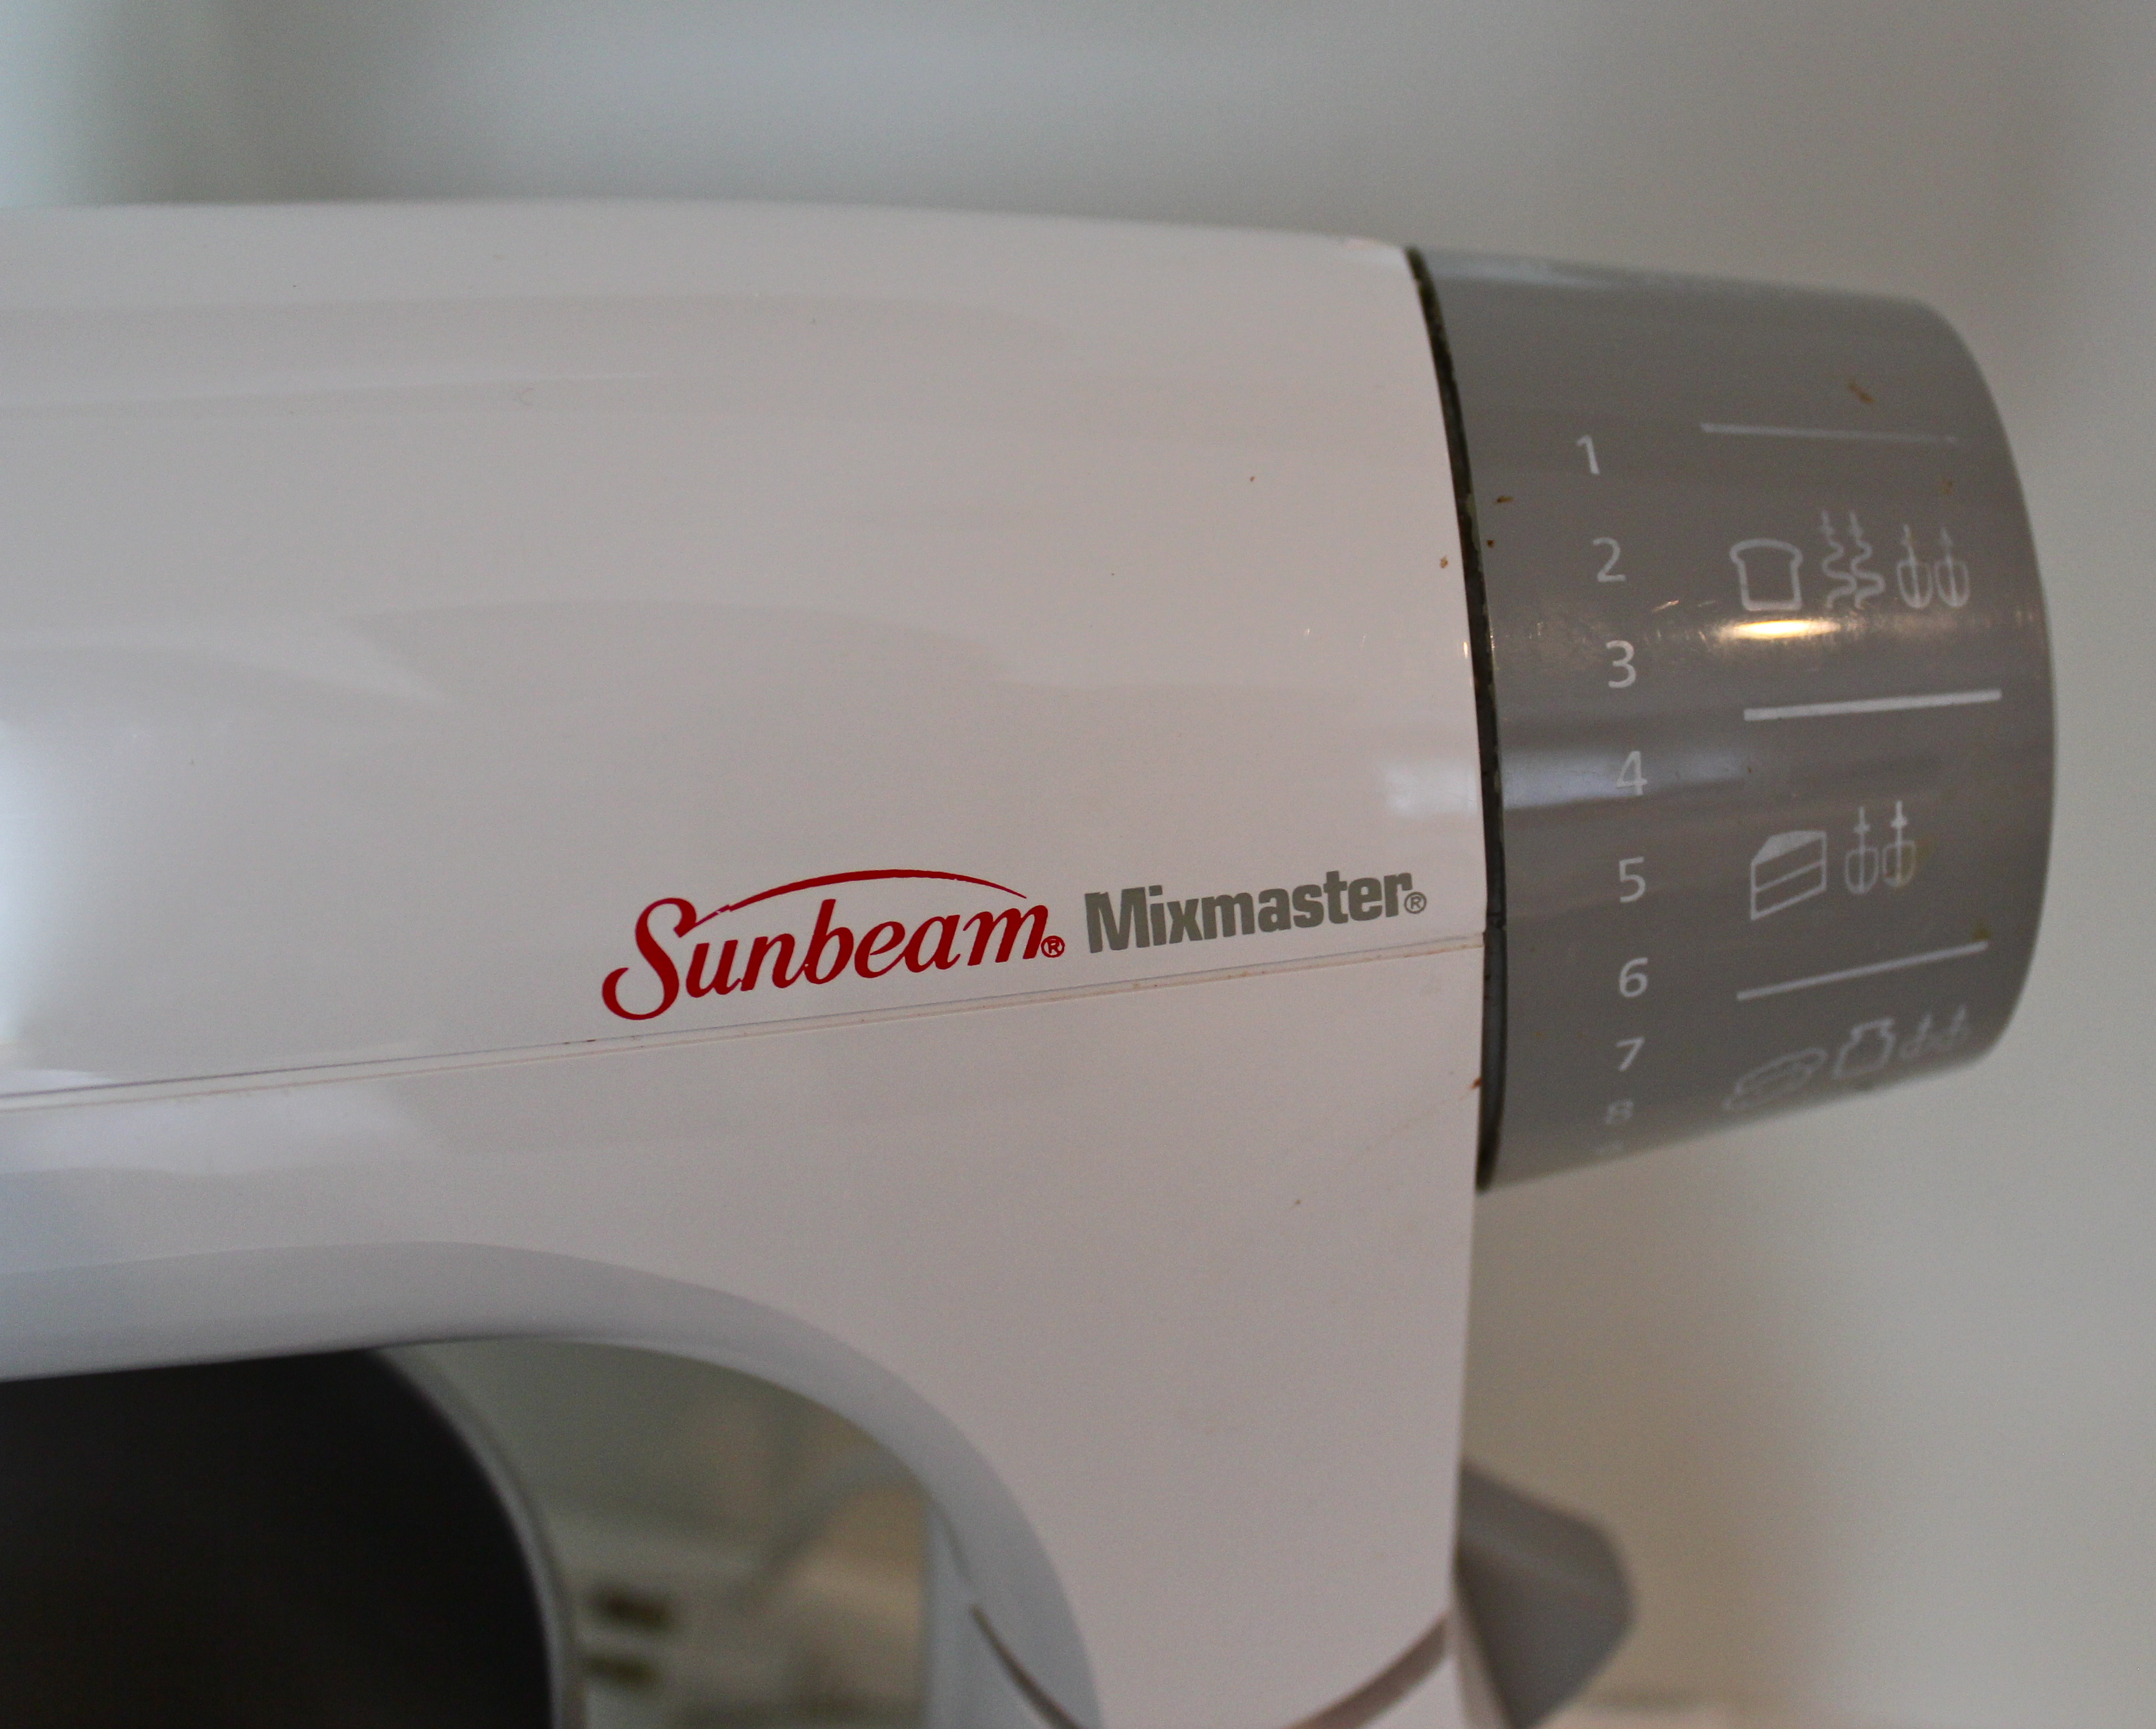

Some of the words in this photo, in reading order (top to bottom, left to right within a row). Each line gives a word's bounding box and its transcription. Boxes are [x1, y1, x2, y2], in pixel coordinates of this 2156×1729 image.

[1577, 435, 1600, 475] 1
[1593, 537, 1626, 582] 2
[1606, 640, 1637, 688] 3
[1615, 751, 1648, 796] 4
[1619, 856, 1646, 903] 5
[1619, 957, 1649, 998] 6
[1615, 1036, 1645, 1072] 7
